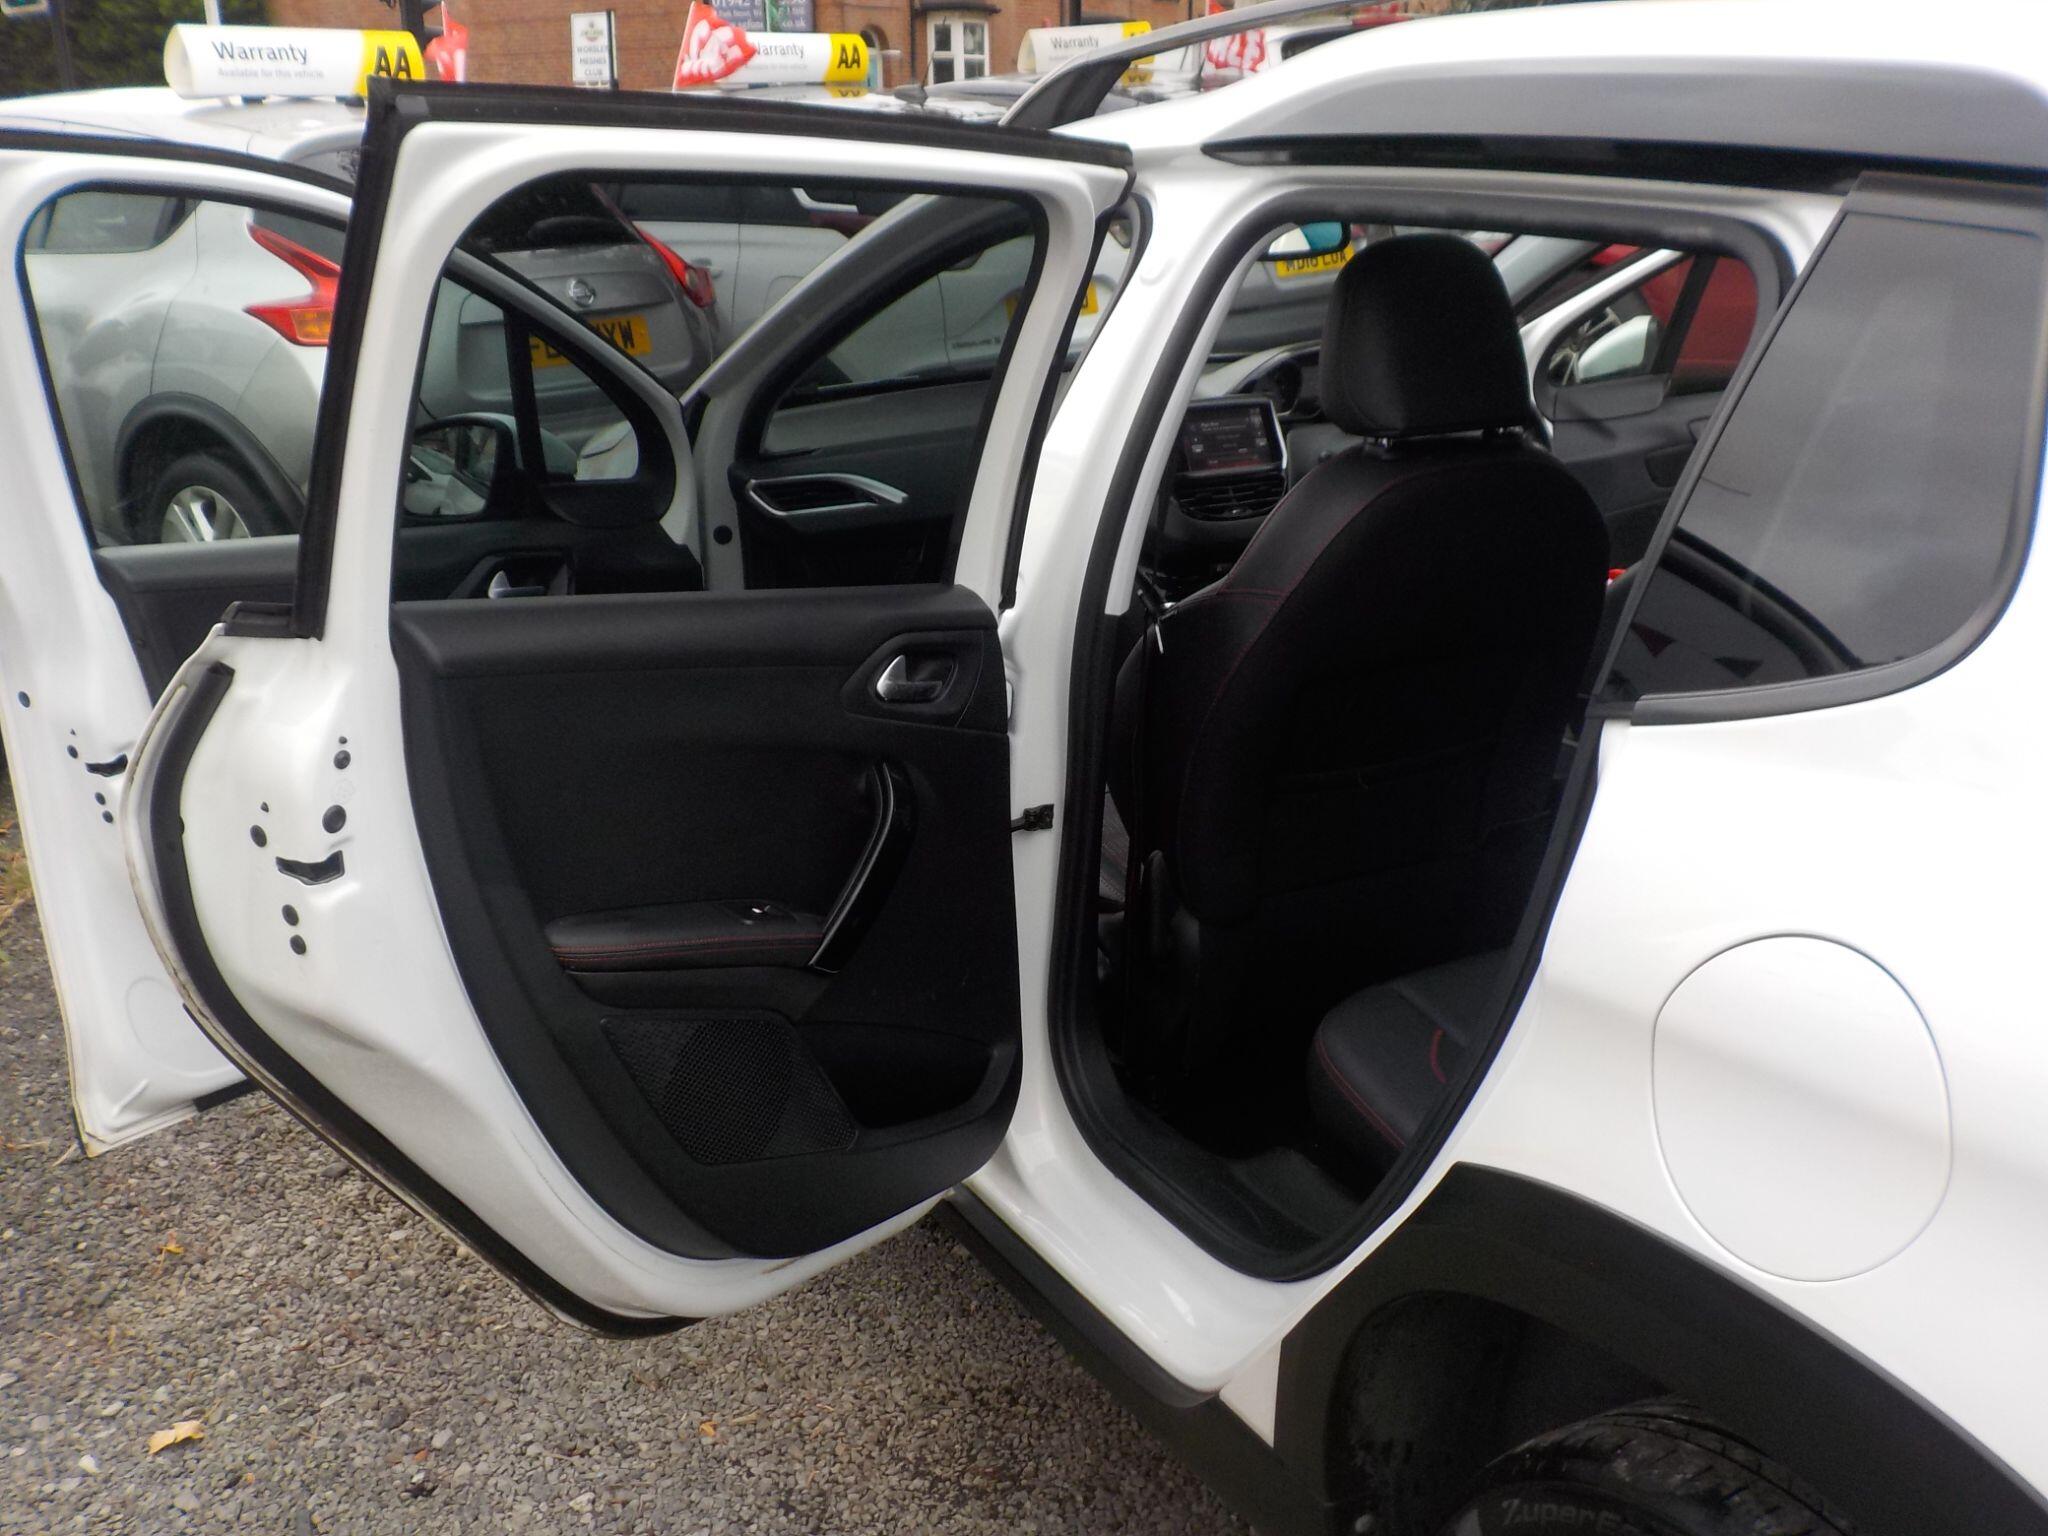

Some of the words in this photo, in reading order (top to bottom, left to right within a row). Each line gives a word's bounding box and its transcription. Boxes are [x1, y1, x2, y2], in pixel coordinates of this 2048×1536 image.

[211, 40, 309, 65] Warranty
[1050, 35, 1099, 49] Warranty
[374, 46, 412, 80] AA
[838, 43, 862, 69] AA
